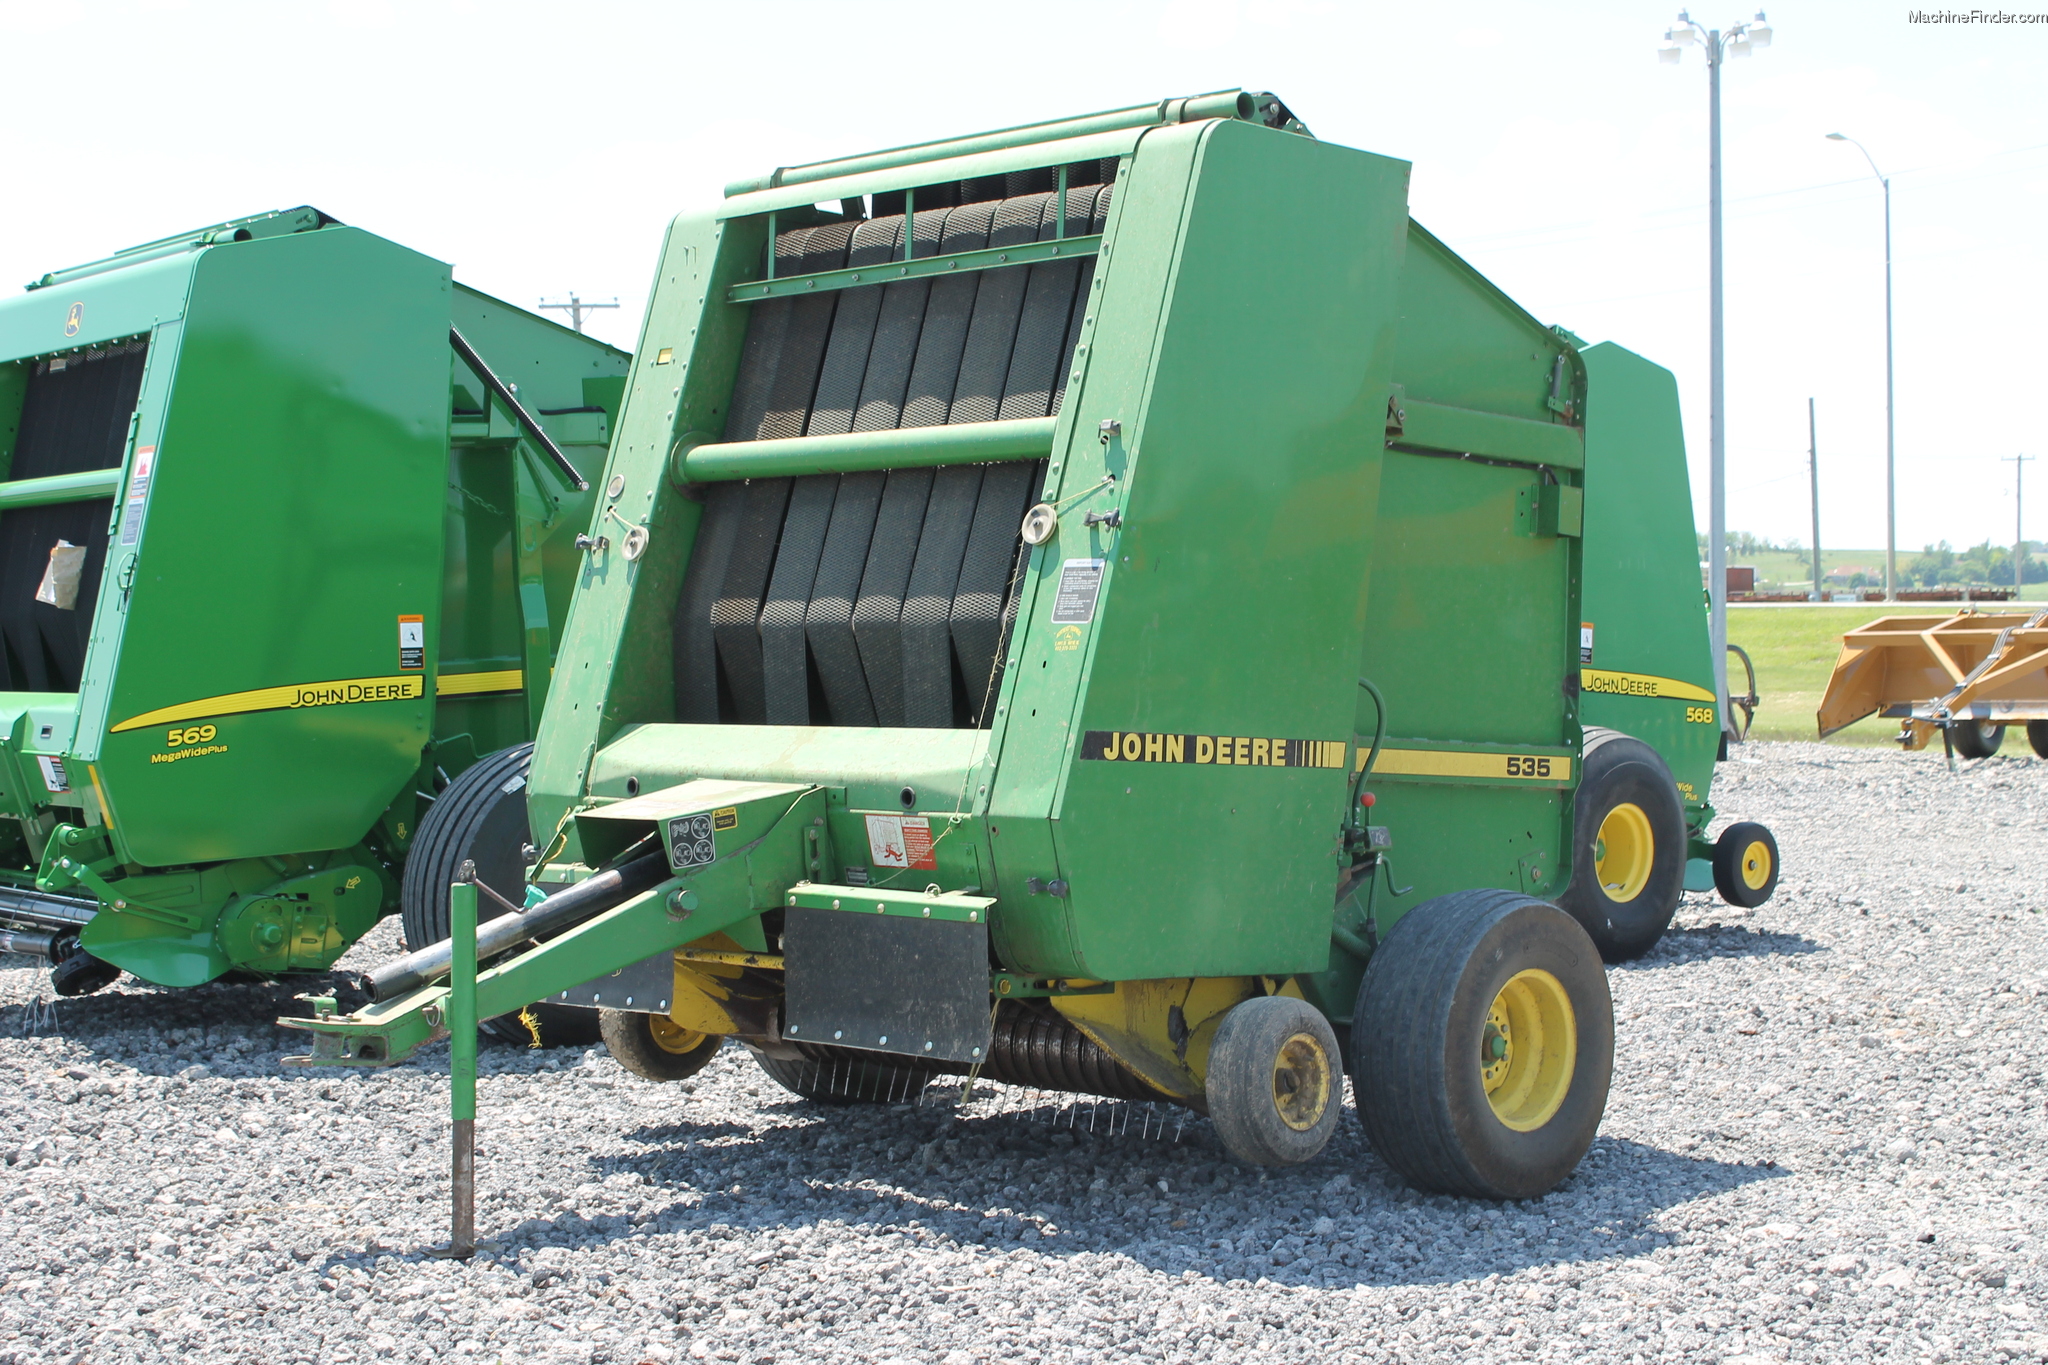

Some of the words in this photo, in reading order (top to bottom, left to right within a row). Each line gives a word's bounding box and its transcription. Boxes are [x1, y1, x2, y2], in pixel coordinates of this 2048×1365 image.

[290, 688, 344, 706] JOHN
[347, 684, 412, 700] DEERE
[1586, 674, 1619, 691] JOHN
[1621, 677, 1658, 695] DEERE
[1686, 706, 1713, 724] 568
[167, 724, 217, 747] 569
[1103, 731, 1185, 764] JOHN
[1195, 735, 1287, 767] DEERE
[1507, 756, 1550, 777] 535
[1684, 792, 1698, 801] Plus
